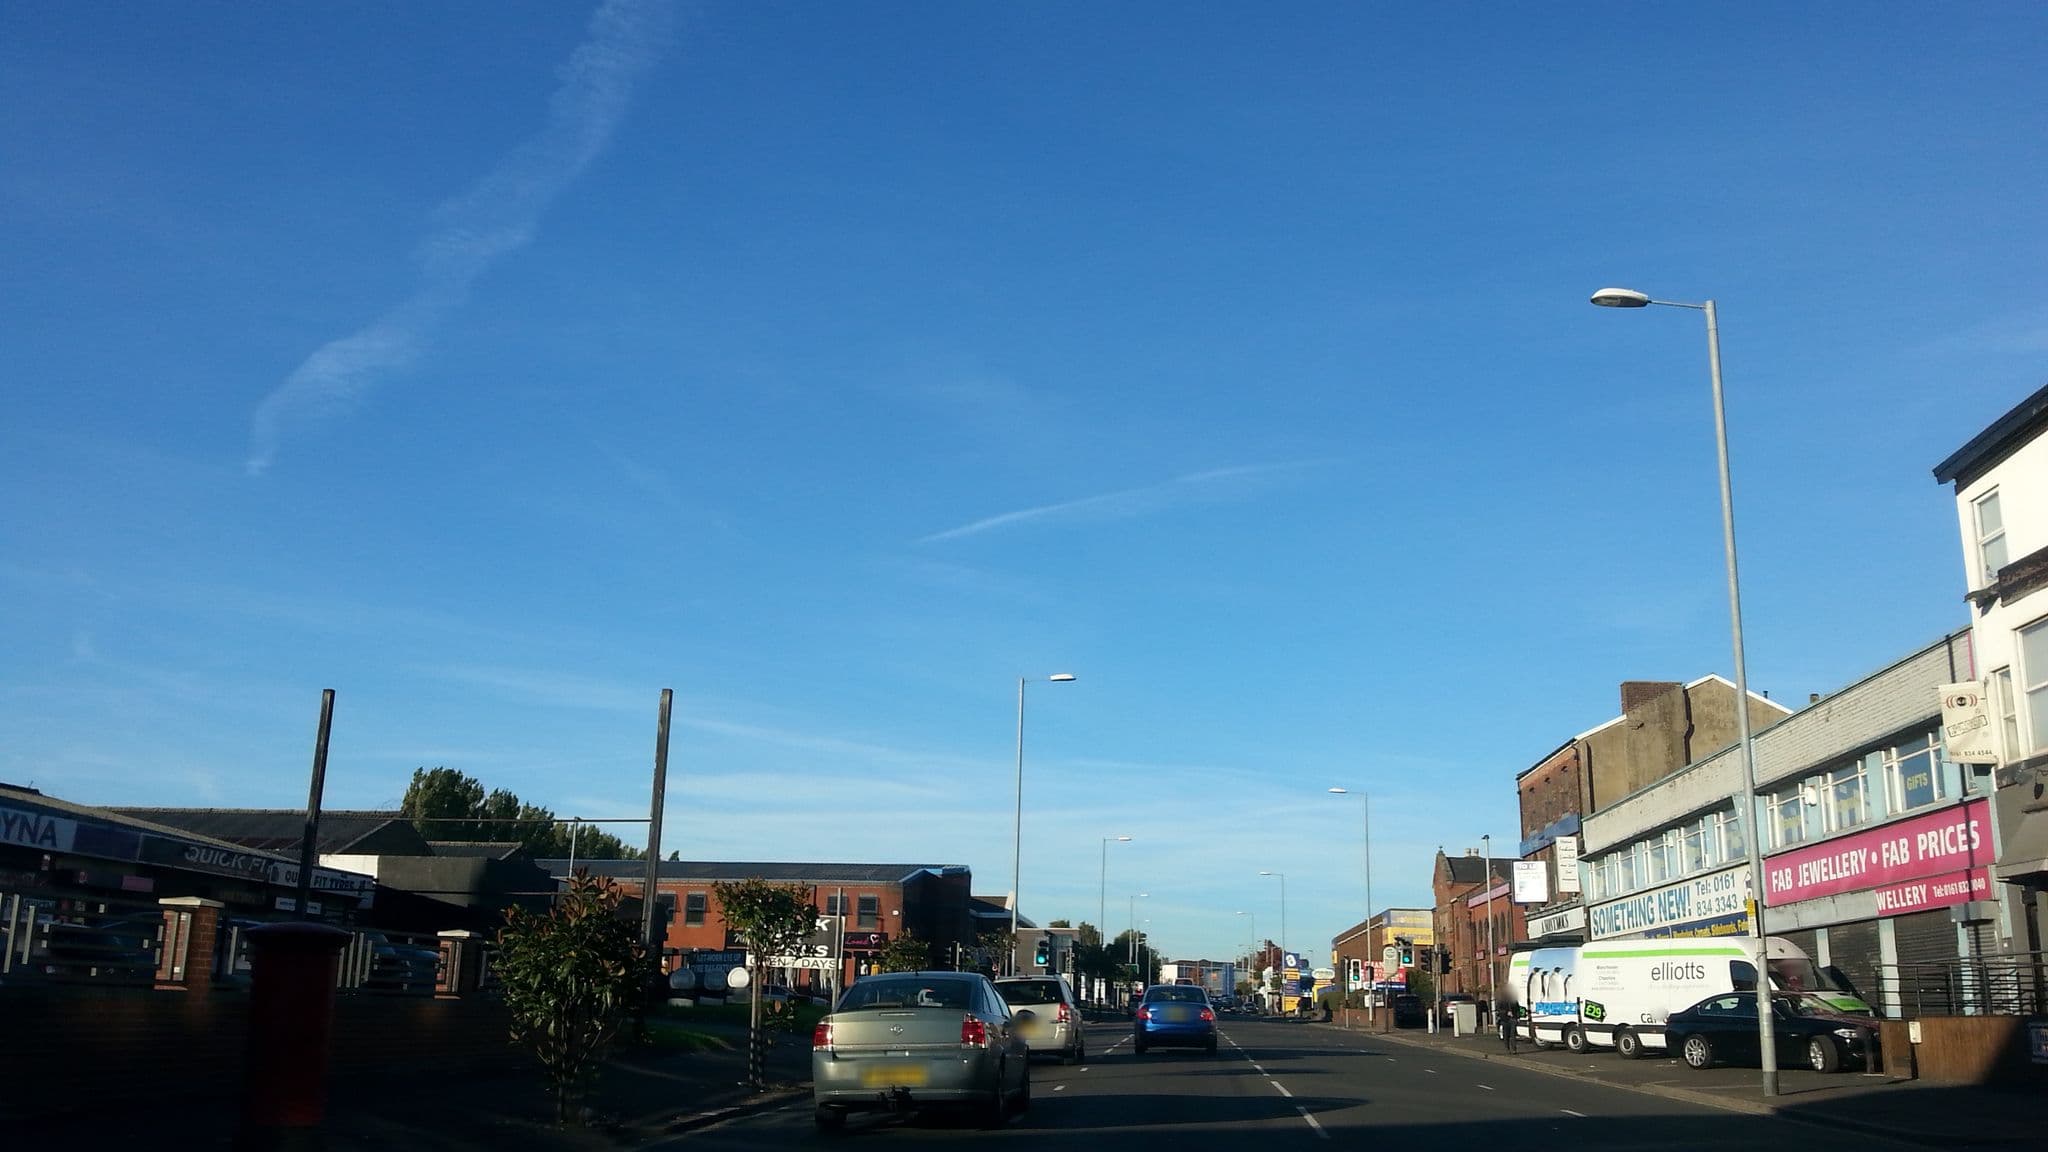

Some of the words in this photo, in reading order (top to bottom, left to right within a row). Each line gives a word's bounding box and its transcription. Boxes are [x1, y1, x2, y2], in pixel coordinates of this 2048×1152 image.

[1906, 772, 1929, 791] GIFTS
[184, 845, 245, 870] QUICK
[248, 858, 271, 875] FI
[1771, 867, 1793, 893] FAB
[1798, 847, 1868, 888] JEWELLERY
[1881, 838, 1910, 868] FAB
[1917, 820, 1980, 861] PRICES
[1695, 880, 1712, 896] Tel:
[1713, 871, 1736, 892] 0161
[1696, 899, 1713, 917] 834
[1715, 894, 1738, 913] 3343
[1875, 883, 1927, 911] WELLERY
[1592, 895, 1655, 936] SOMETHING
[1658, 885, 1692, 922] NEW!
[801, 957, 837, 969] DAYS
[1651, 961, 1706, 981] elliotts
[1585, 1004, 1602, 1018] £29
